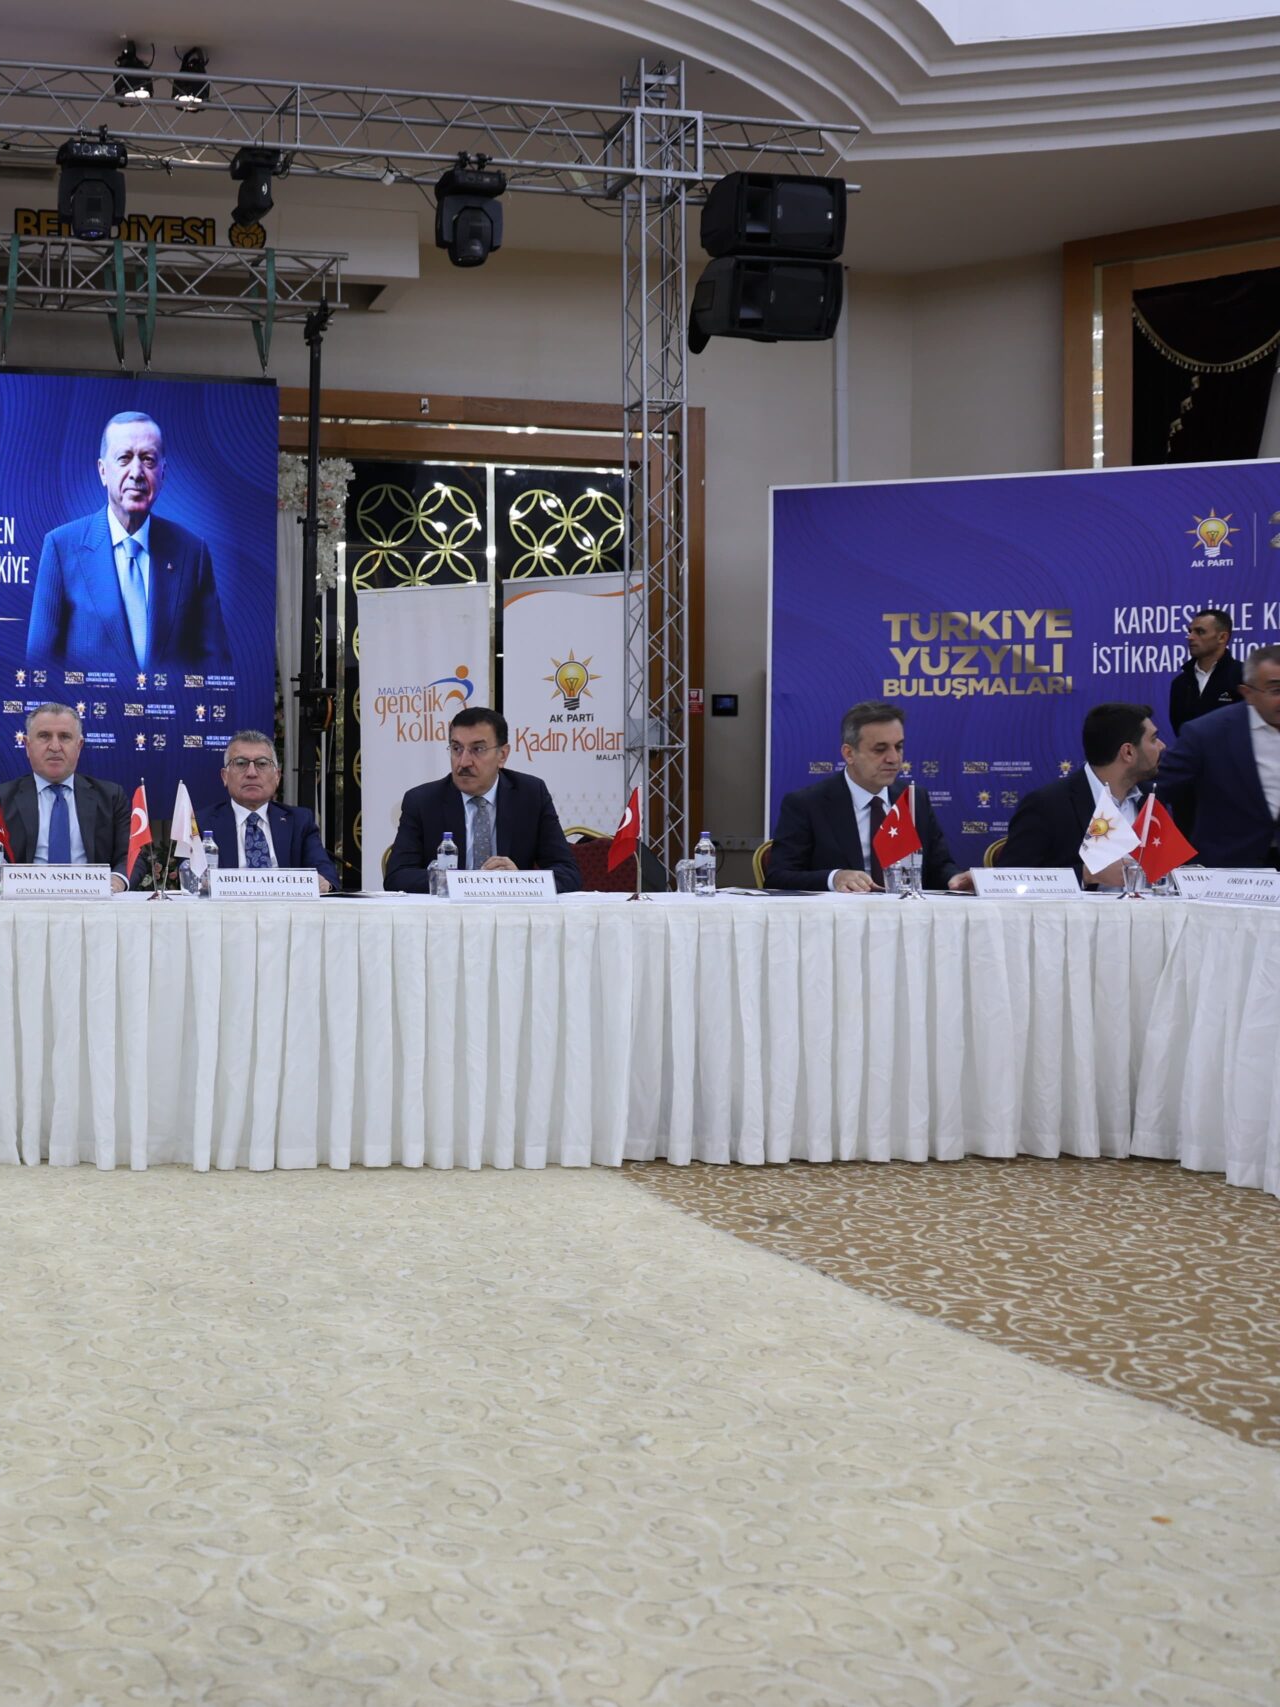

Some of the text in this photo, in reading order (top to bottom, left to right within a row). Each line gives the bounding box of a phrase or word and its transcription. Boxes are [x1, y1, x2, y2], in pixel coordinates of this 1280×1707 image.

[1190, 558, 1234, 568] AK PARTİ
[378, 687, 422, 696] MALATYA
[883, 676, 1073, 700] BULUŞMALARI
[374, 686, 443, 727] gençlik
[549, 713, 594, 723] AK PARTİ
[397, 713, 450, 742] kolla
[515, 727, 625, 762] Kadın Kollar
[9, 872, 47, 880] OSMAN
[49, 872, 82, 882] AŞKIN
[277, 875, 313, 884] GÜLER
[458, 875, 494, 883] BÜLENT
[993, 873, 1031, 881] MEVLÜT
